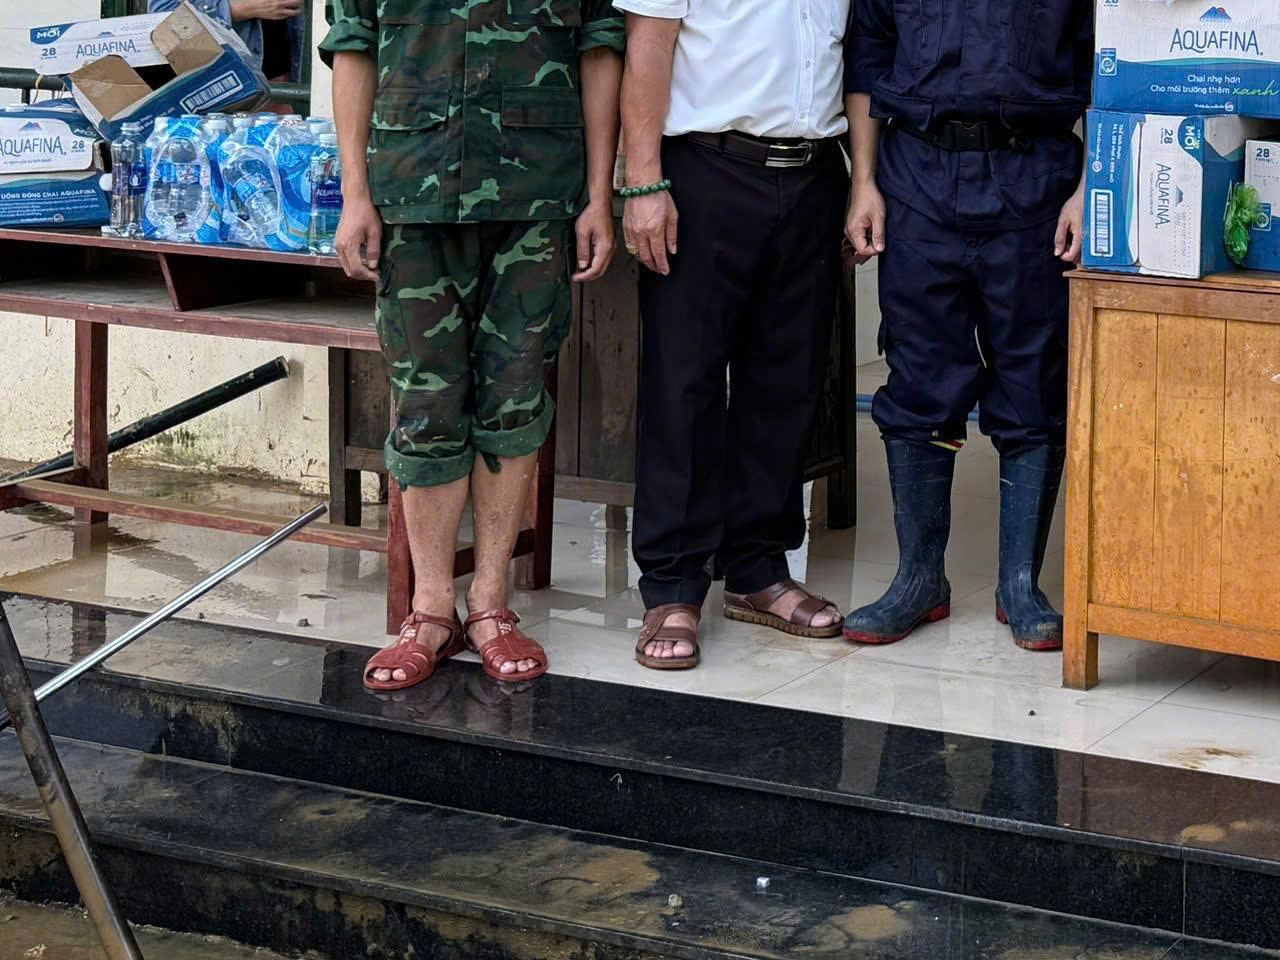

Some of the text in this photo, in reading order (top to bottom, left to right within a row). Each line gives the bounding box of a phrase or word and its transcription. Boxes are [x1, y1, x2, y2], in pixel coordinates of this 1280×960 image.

[1169, 28, 1260, 55] AQUAFINA
[41, 47, 57, 56] 28
[75, 39, 137, 58] AQUAFINA
[1187, 74, 1206, 83] Chai
[1150, 84, 1166, 93] Cho
[1231, 79, 1280, 96] xanh
[1164, 129, 1173, 144] 28
[71, 140, 85, 149] 28
[1256, 147, 1270, 158] 28
[60, 188, 96, 197] AQUAFINA
[1156, 163, 1172, 225] AQUAFINA
